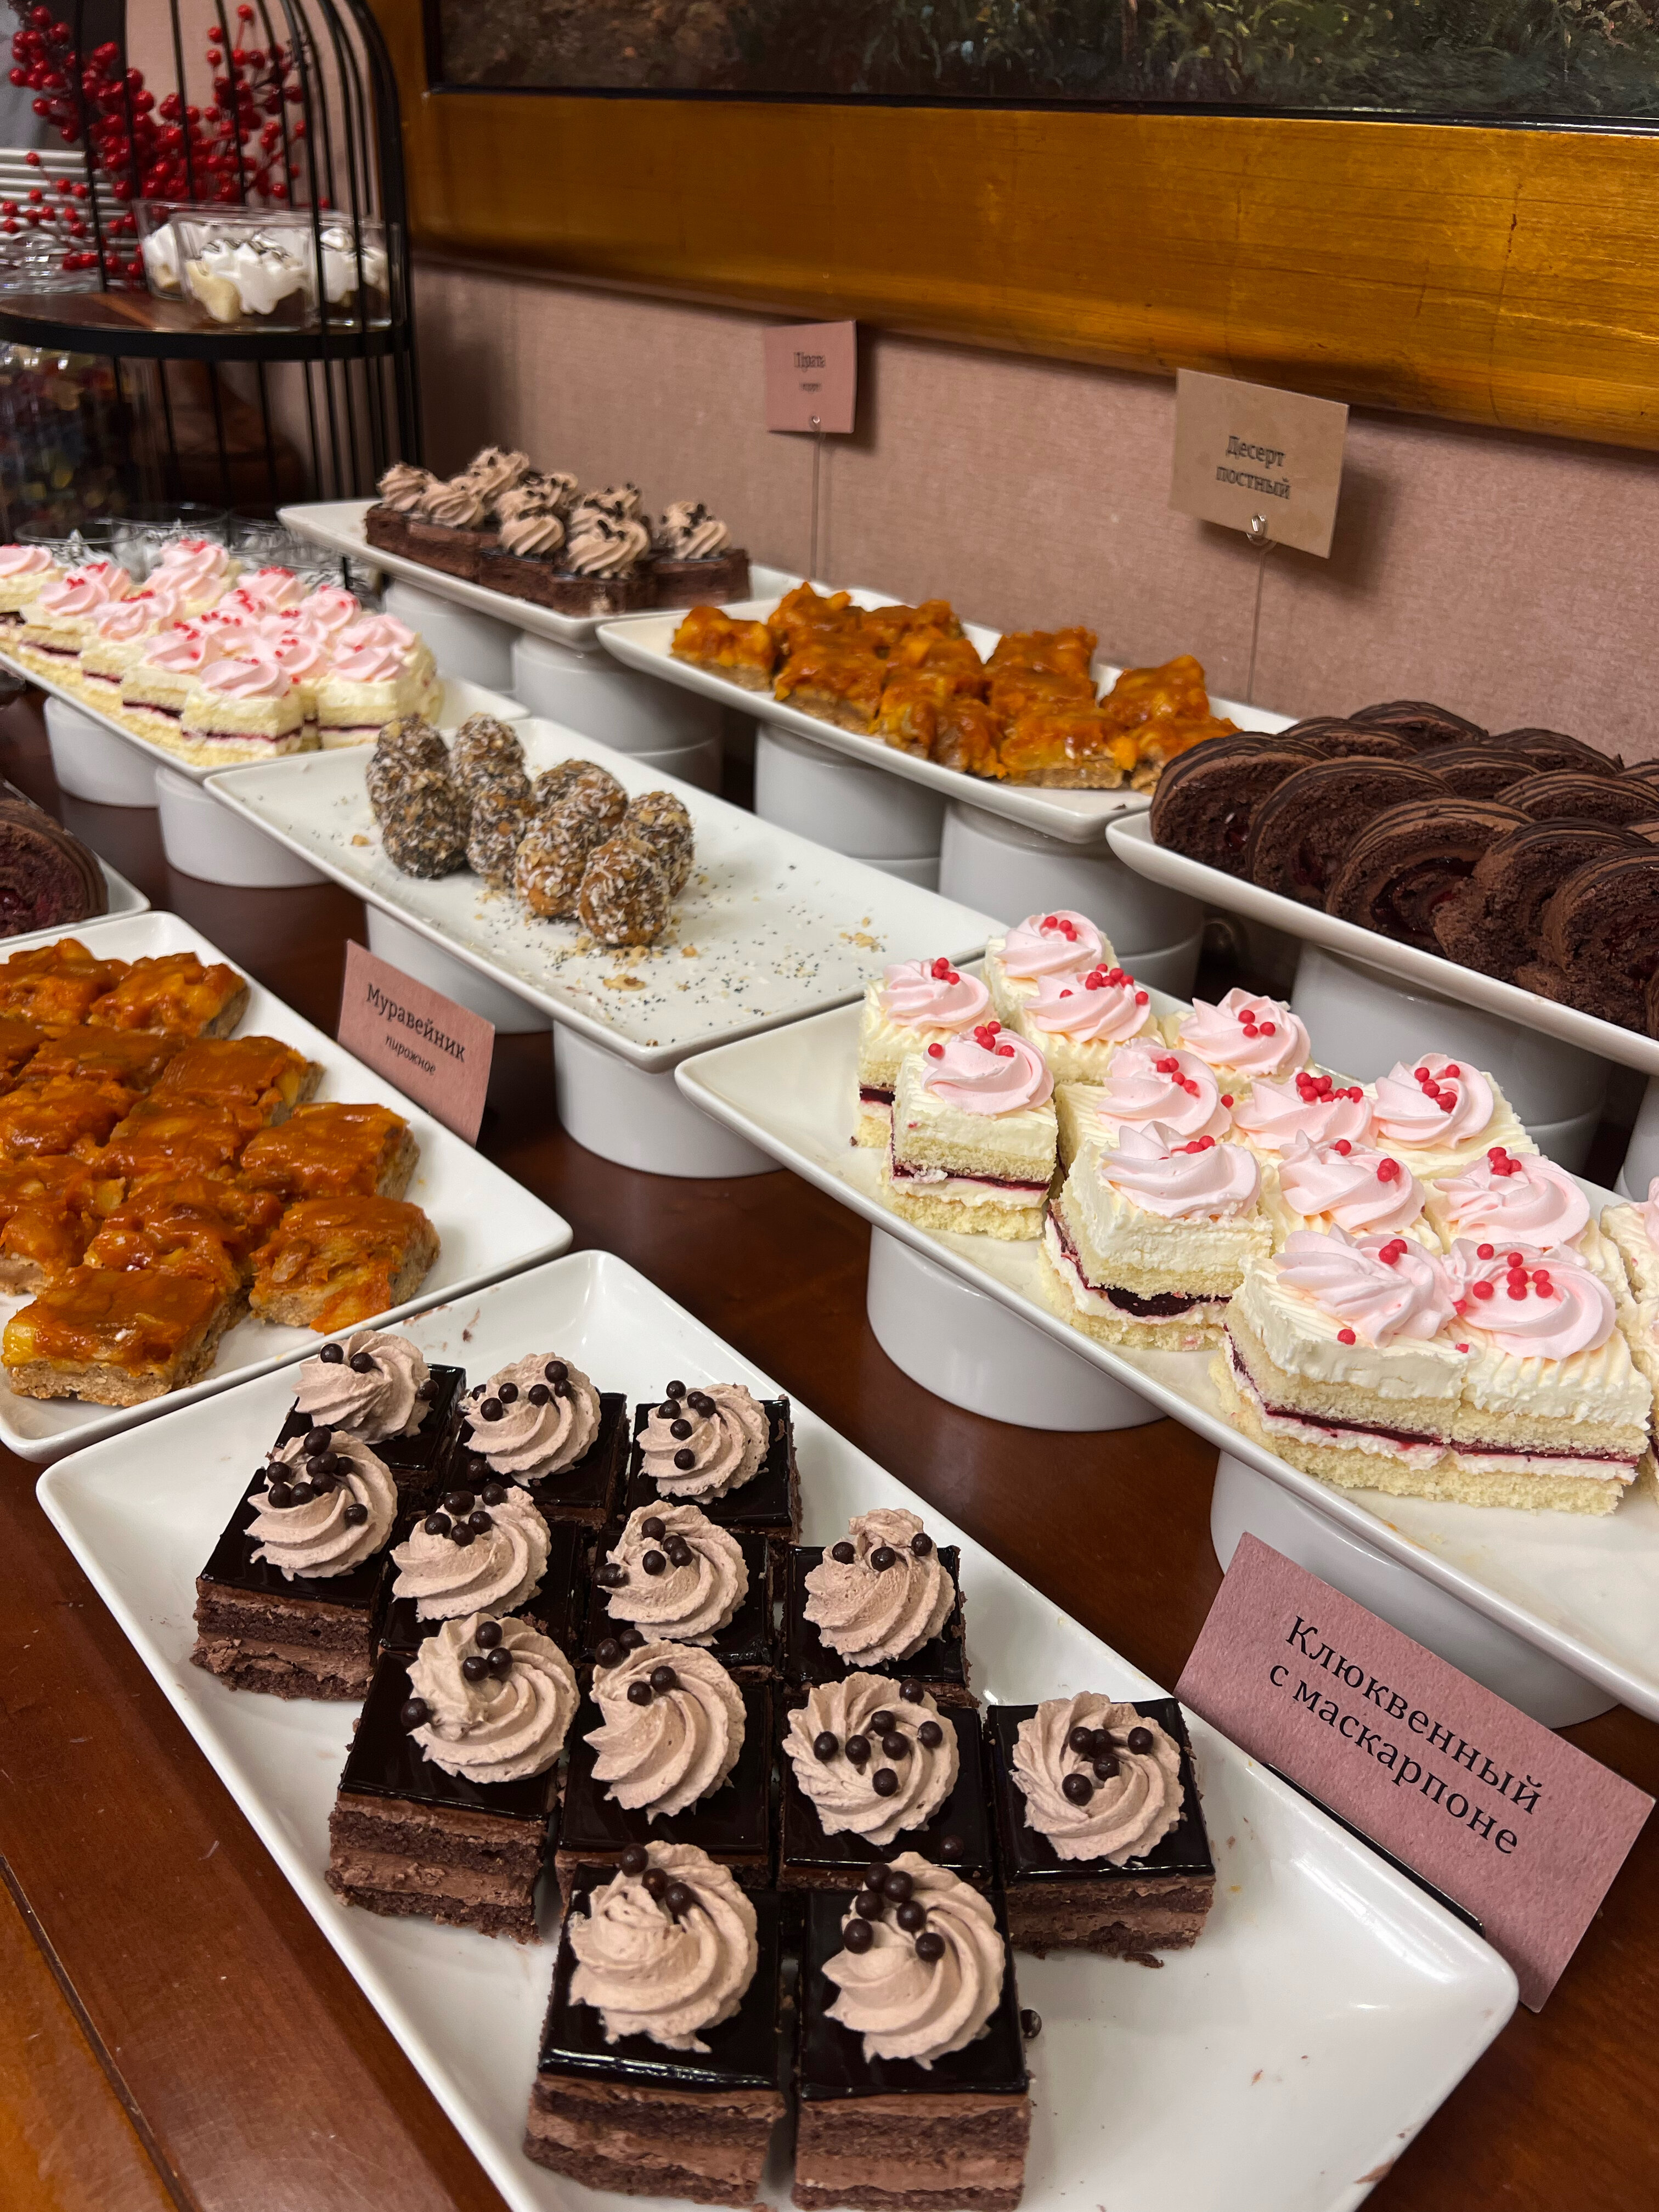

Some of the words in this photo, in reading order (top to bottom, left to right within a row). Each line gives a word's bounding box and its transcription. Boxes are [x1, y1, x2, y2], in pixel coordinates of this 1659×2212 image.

[1226, 436, 1285, 469] Десерт
[1216, 466, 1291, 499] постный
[366, 983, 465, 1062] Муравейник
[385, 1035, 436, 1075] пирожное
[1285, 1616, 1542, 1815] Клюквенный
[1270, 1665, 1289, 1687] с
[1293, 1680, 1517, 1854] маскарпоне
